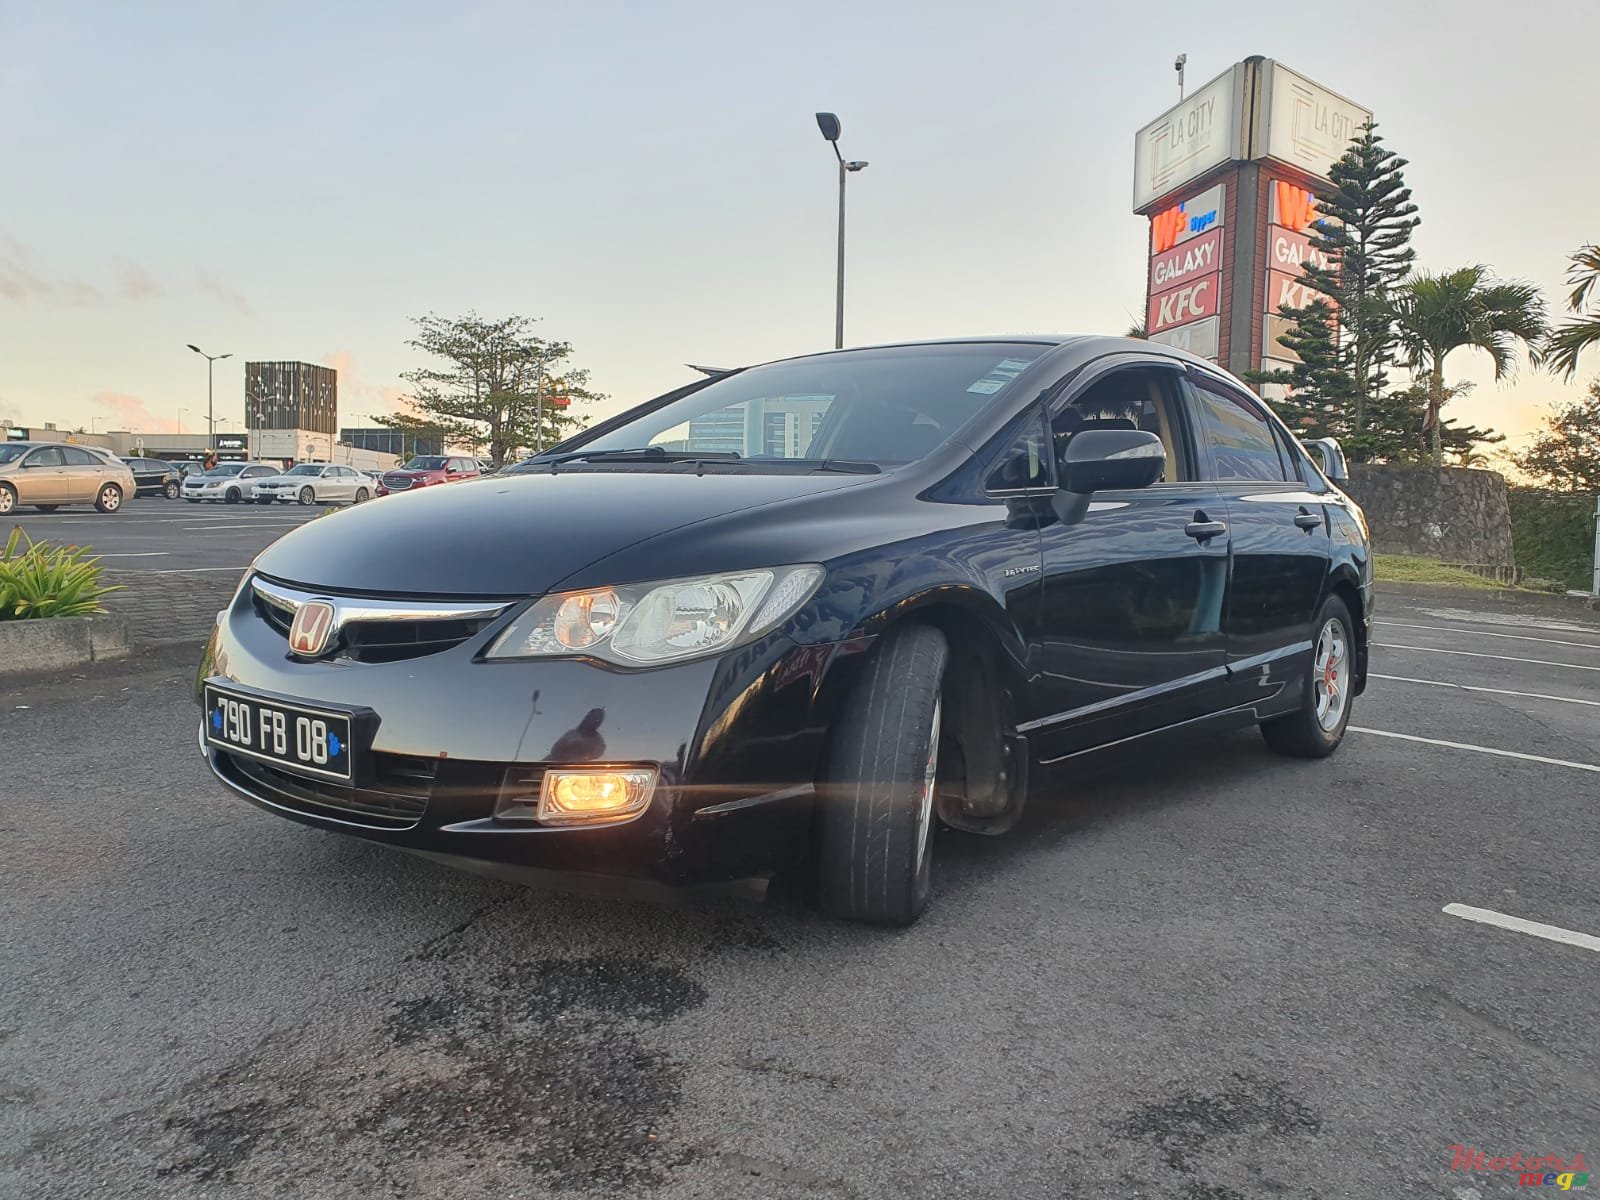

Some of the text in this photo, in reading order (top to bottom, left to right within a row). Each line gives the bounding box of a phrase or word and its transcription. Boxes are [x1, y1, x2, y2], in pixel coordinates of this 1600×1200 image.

[1171, 118, 1184, 149] LA
[1315, 102, 1328, 135] LA
[1190, 210, 1216, 232] Hyper
[1155, 240, 1215, 285] GALAXY
[1156, 281, 1208, 328] KFC
[218, 697, 328, 765] 790 FB 08
